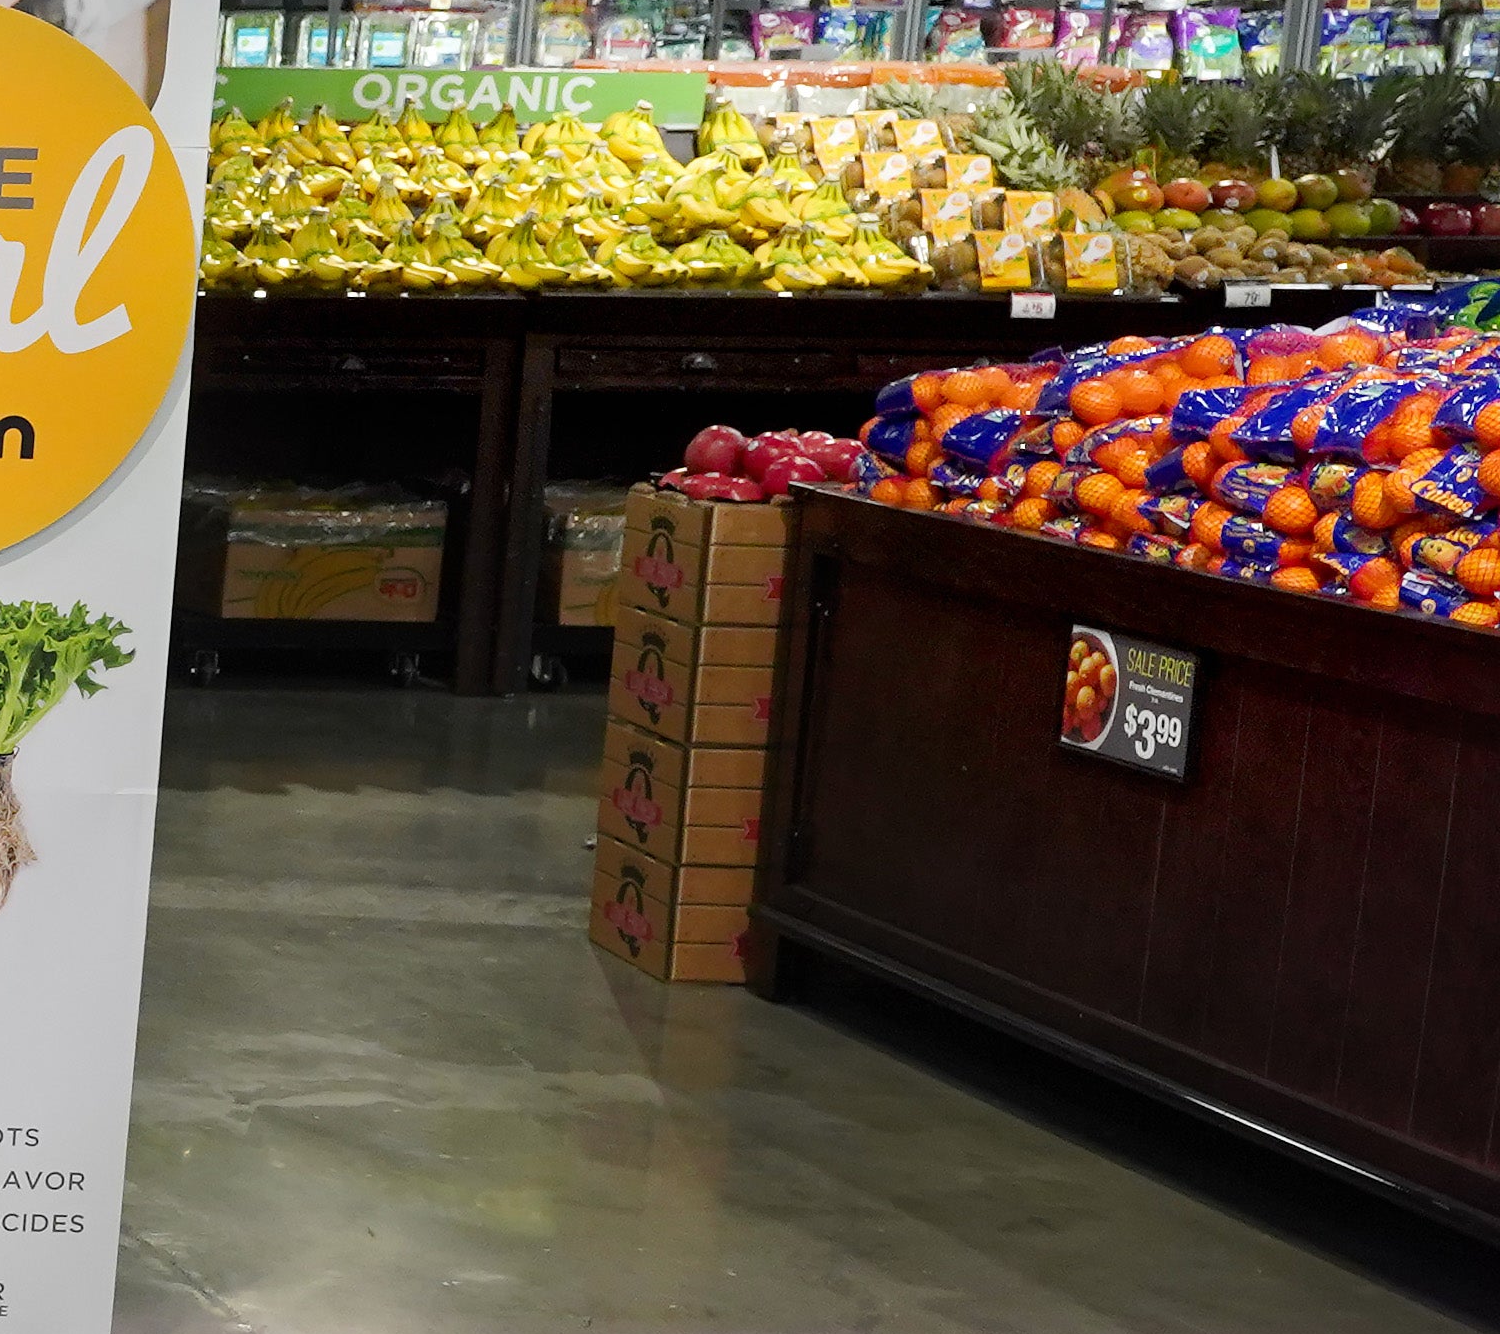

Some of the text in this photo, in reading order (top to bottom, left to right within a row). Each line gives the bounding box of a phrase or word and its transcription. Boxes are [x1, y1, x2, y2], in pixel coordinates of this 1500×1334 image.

[353, 74, 594, 113] ORGANIC
[1128, 649, 1194, 687] SALE PRICE
